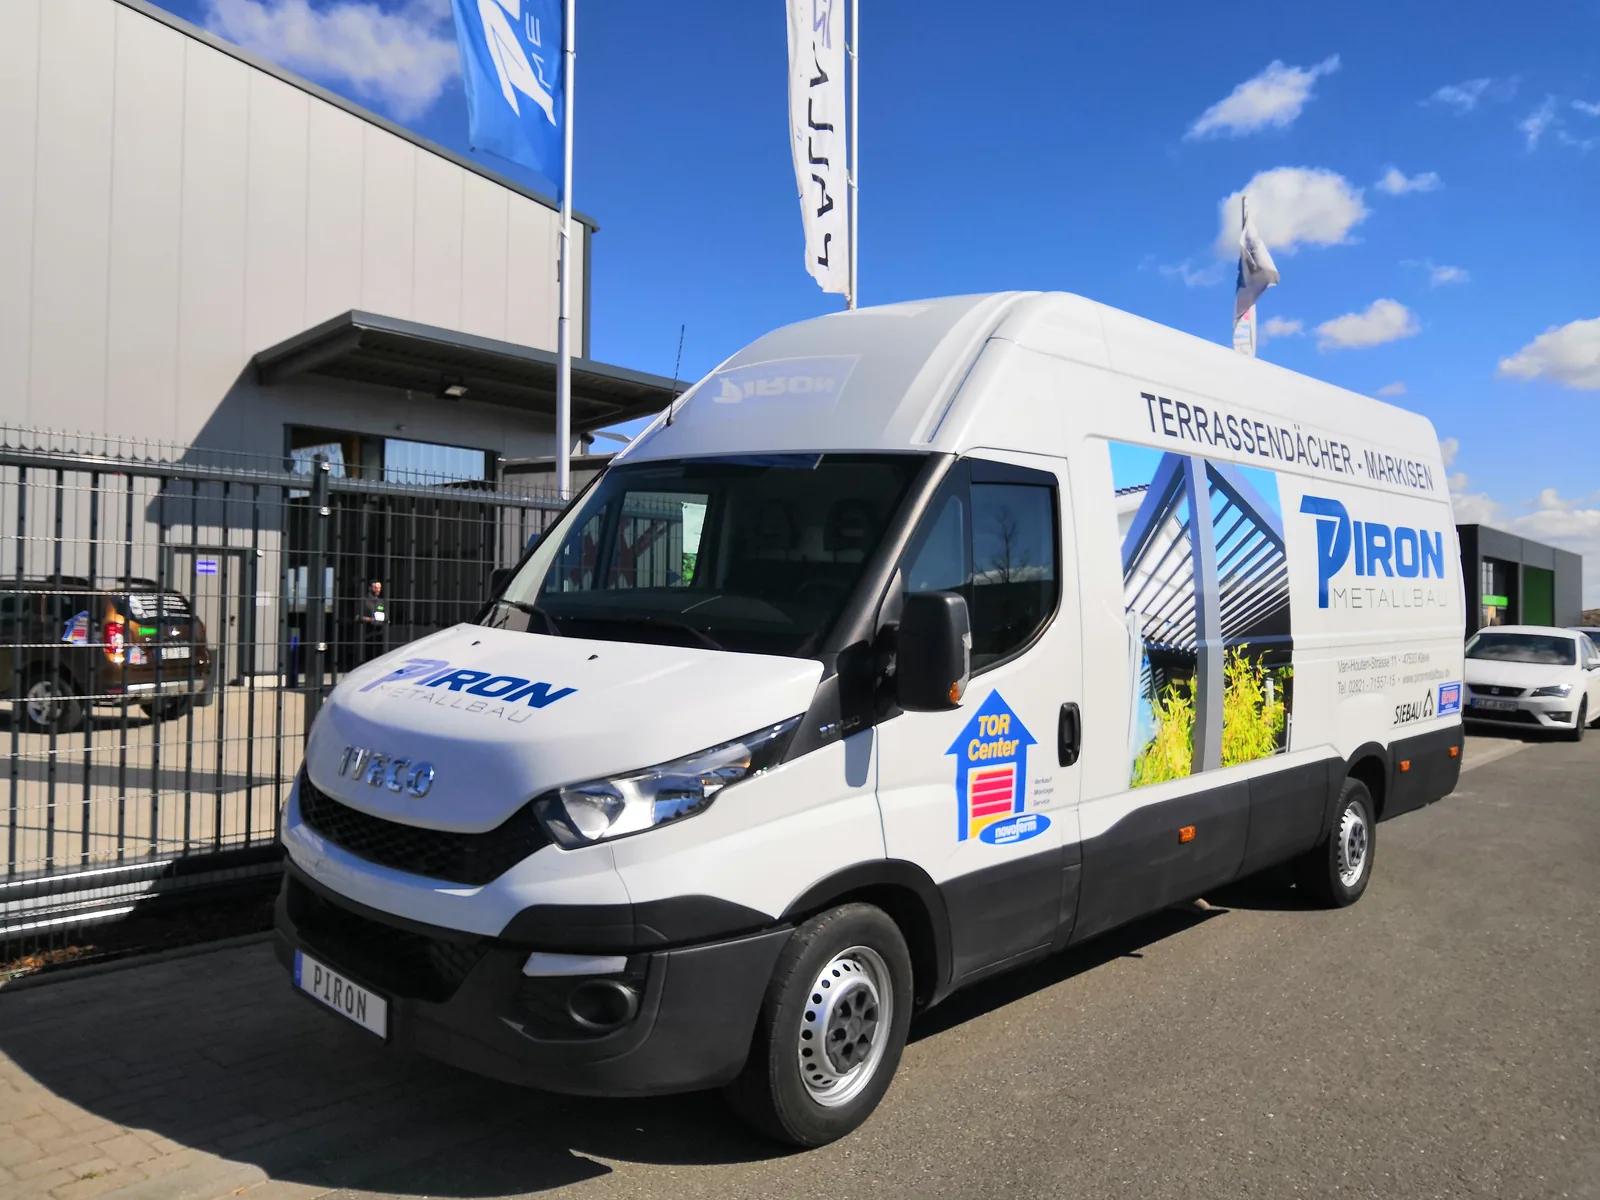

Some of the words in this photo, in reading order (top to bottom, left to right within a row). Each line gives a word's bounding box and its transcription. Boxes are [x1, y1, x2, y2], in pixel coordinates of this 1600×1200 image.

[1140, 391, 1355, 476] TERRASSENDÄCHER
[1363, 449, 1435, 491] MARKISEN
[1299, 494, 1445, 609] PIRON
[1333, 587, 1448, 609] METALLBAU
[359, 658, 579, 709] PIRON
[370, 685, 533, 723] METALLBAU
[1393, 701, 1423, 725] SIEBAU
[978, 713, 1011, 737] TOR
[968, 737, 1019, 761] Center
[338, 743, 436, 798] IVECO
[994, 814, 1038, 844] novoferm
[313, 964, 367, 1023] PIRON
